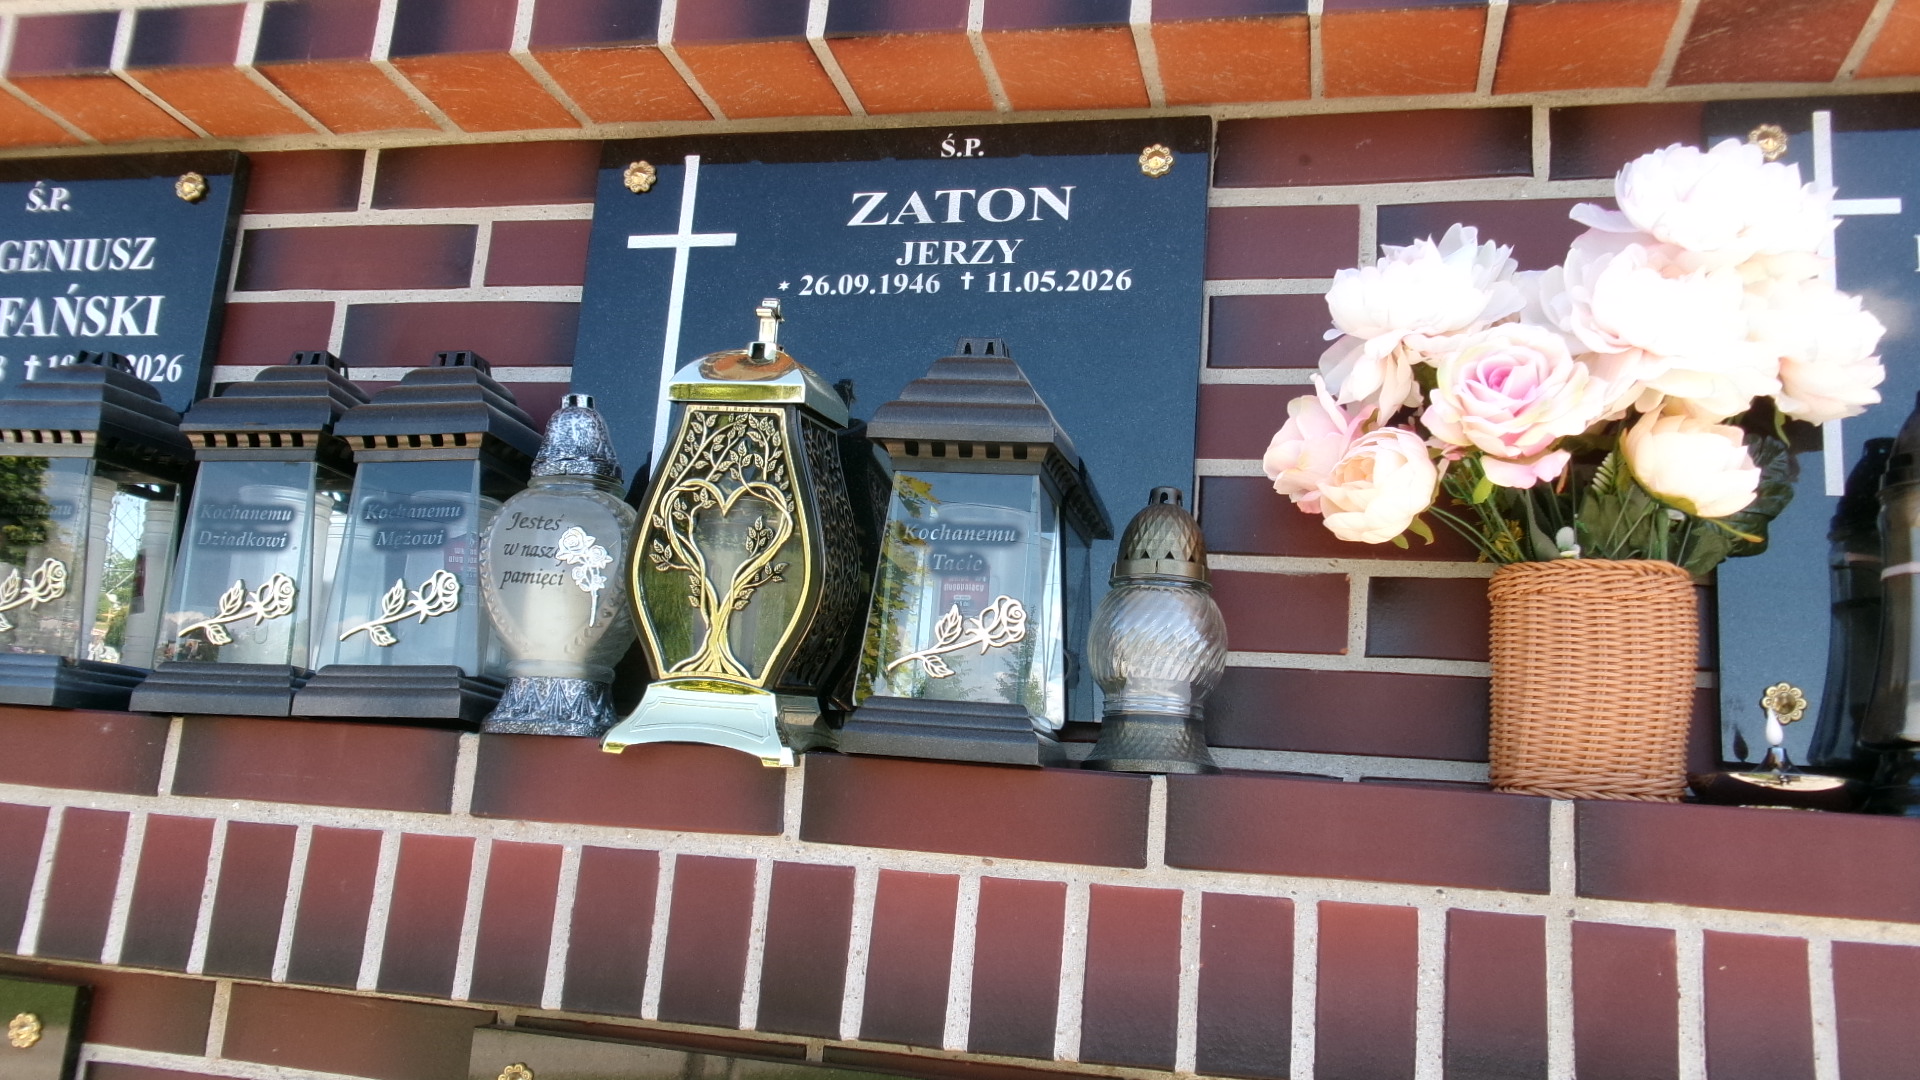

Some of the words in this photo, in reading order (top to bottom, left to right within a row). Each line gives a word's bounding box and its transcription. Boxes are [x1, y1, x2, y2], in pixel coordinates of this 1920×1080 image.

[940, 134, 985, 158] Ś.P.
[26, 181, 71, 211] Ś.P.
[846, 185, 1077, 227] ZATON
[896, 238, 1024, 267] JERZY
[799, 273, 941, 296] 26.09.1946
[985, 268, 1133, 294] 11.05.2026
[200, 504, 292, 521] Kochanemu
[364, 504, 461, 520] Kochanemu
[506, 511, 564, 531] Jesteś
[197, 530, 288, 548] Dziadkowi
[376, 530, 444, 549] Mężowi
[904, 523, 1016, 542] Kochanemu
[503, 543, 520, 556] w
[500, 569, 566, 590] pamięci
